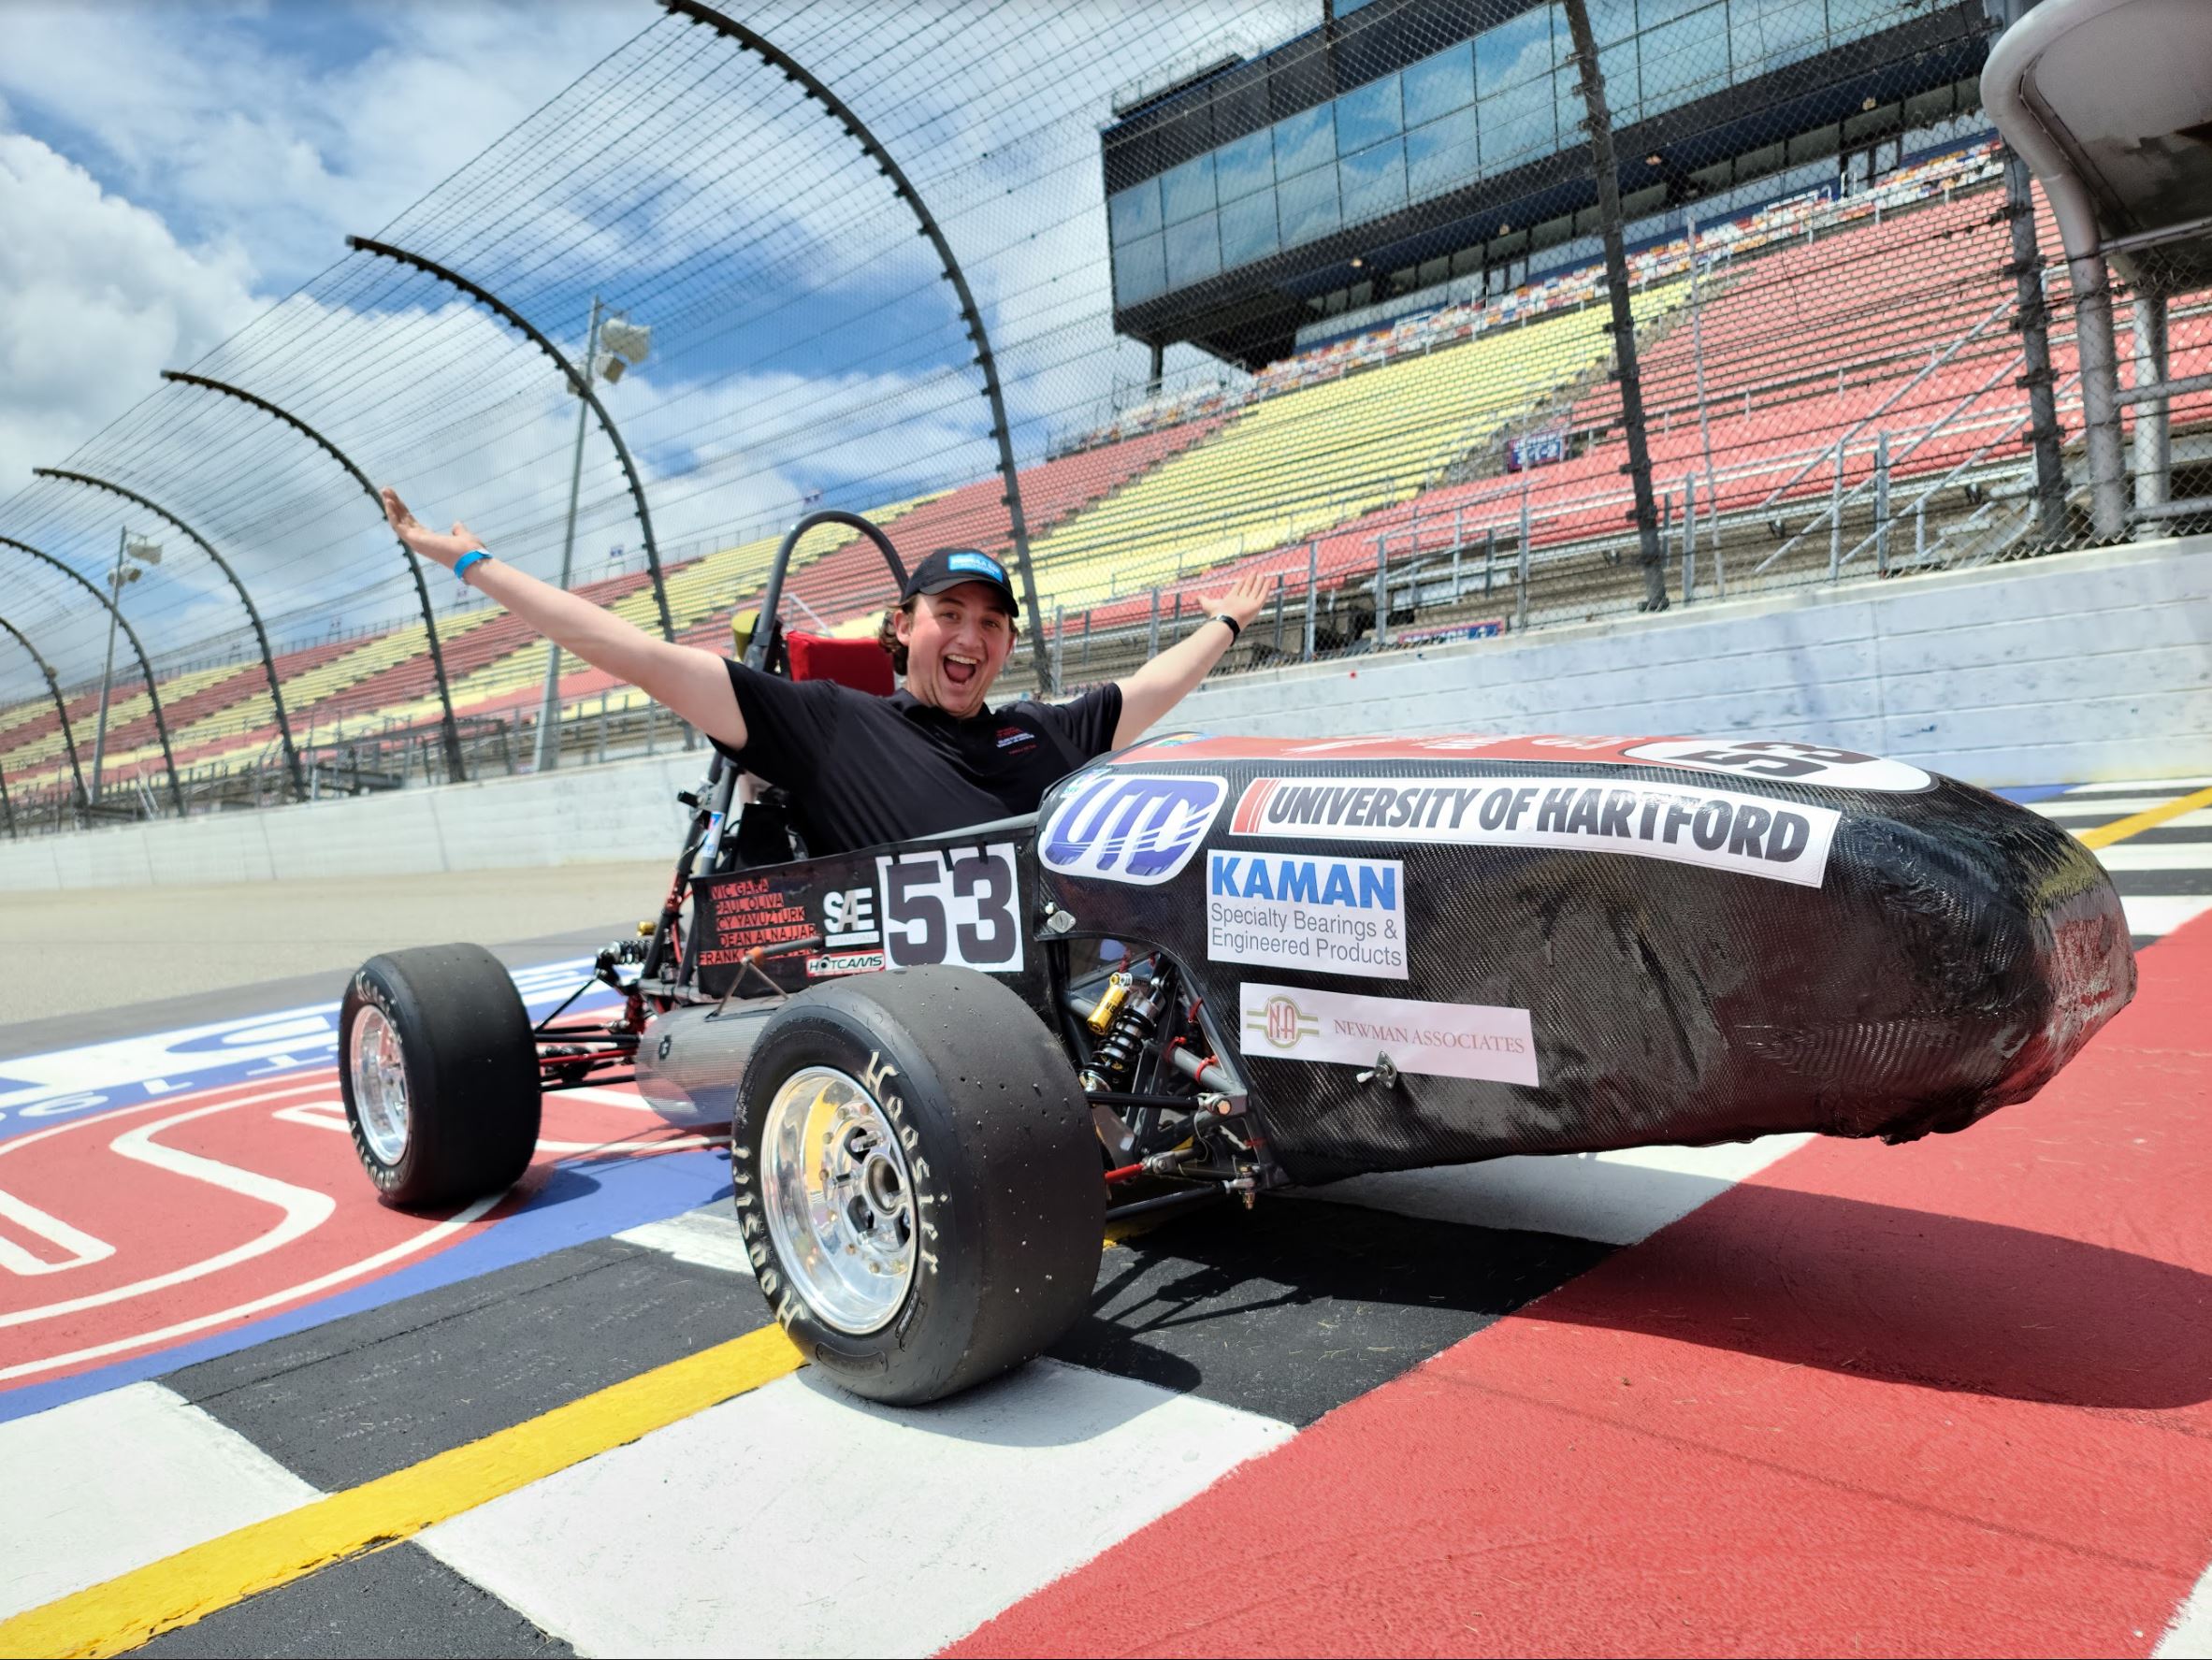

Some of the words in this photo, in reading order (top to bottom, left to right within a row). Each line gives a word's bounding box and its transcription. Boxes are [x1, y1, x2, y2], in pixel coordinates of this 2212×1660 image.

[1662, 742, 1881, 777] 53
[1268, 787, 1483, 829] UNIVERSITY
[1479, 787, 1537, 830] OF
[1536, 787, 1811, 863] HARTFORD
[712, 886, 730, 899] VIC
[1211, 857, 1395, 910] KAMAN
[716, 900, 745, 914] PAUL
[749, 894, 784, 909] OLIVA
[823, 888, 875, 933] SAE
[886, 855, 1017, 966] 53
[1211, 902, 1288, 928] Specialty
[1294, 910, 1376, 941] Bearings
[1384, 919, 1397, 940] &
[717, 917, 731, 931] CY
[719, 932, 752, 946] DEAN
[701, 950, 739, 964] FRANK
[1212, 928, 1309, 957] Engineered
[1317, 933, 1402, 967] Products
[1334, 1018, 1409, 1043] NEWMAN
[1412, 1030, 1525, 1054] ASSOCIATES
